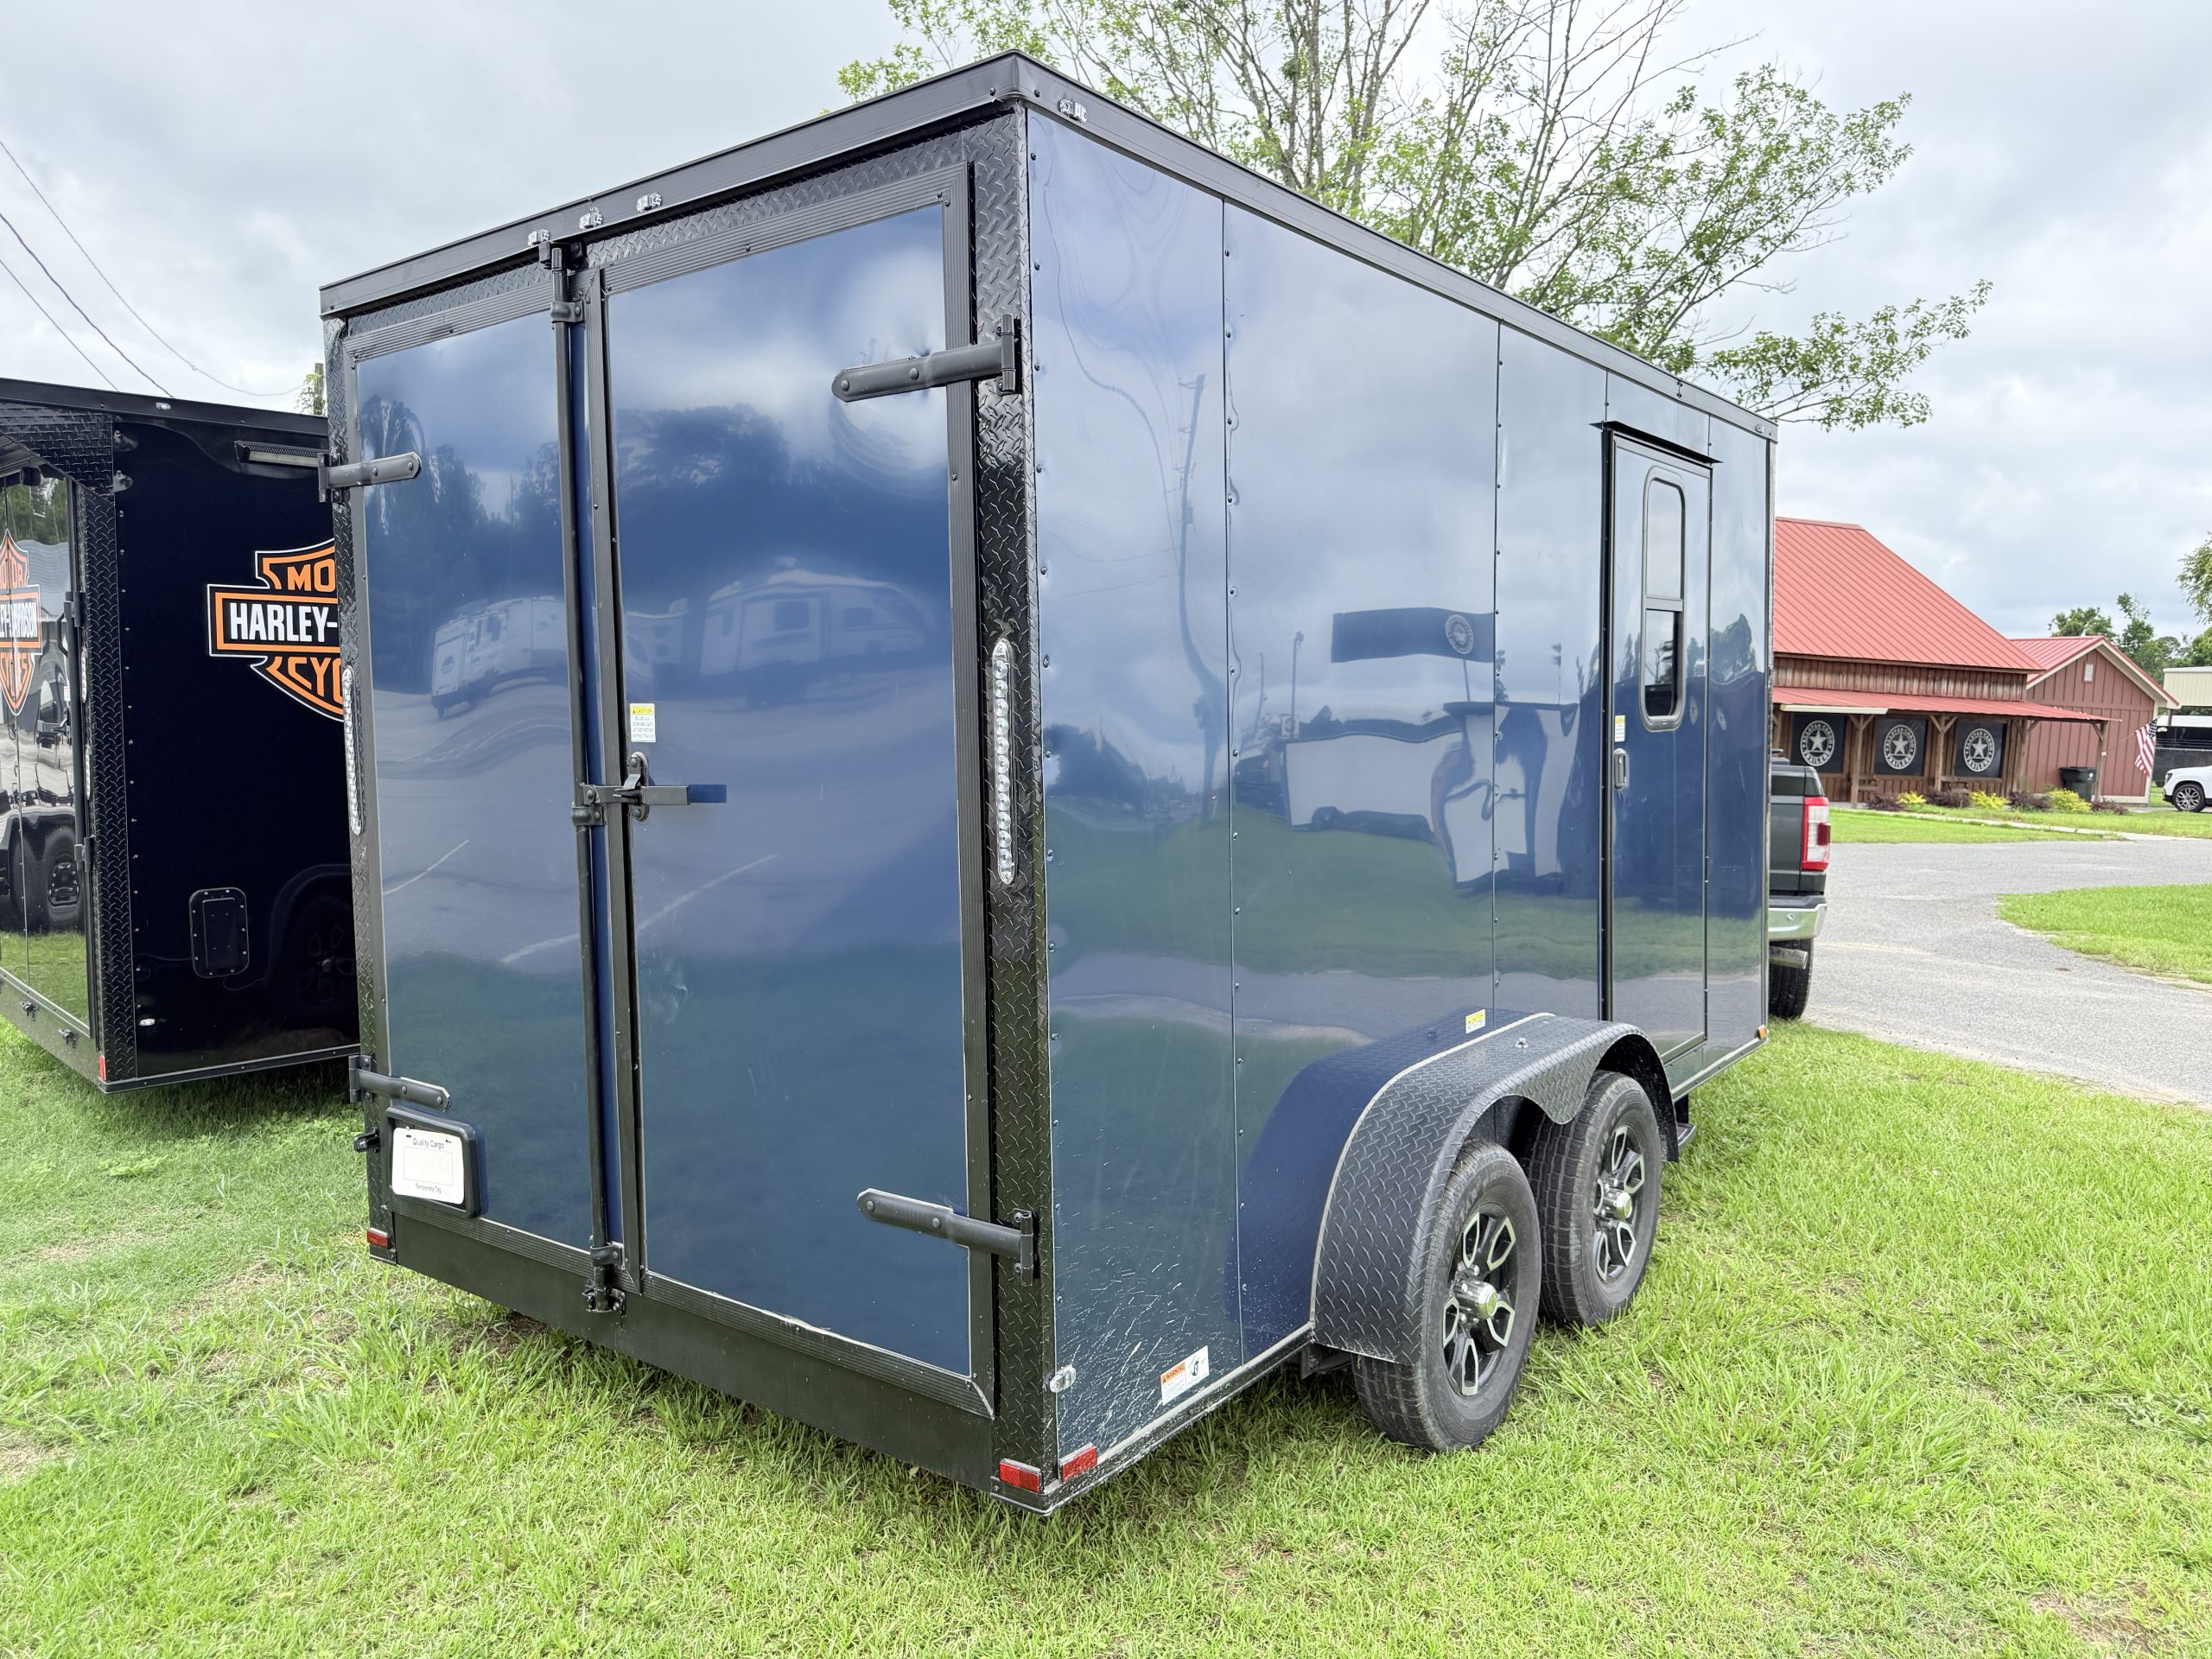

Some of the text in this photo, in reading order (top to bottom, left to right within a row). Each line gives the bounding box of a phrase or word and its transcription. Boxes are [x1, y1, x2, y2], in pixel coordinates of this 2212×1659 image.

[229, 602, 338, 643] HARLEY-
[412, 1137, 445, 1150] Quality Cargo
[415, 1183, 435, 1192] Temporary
